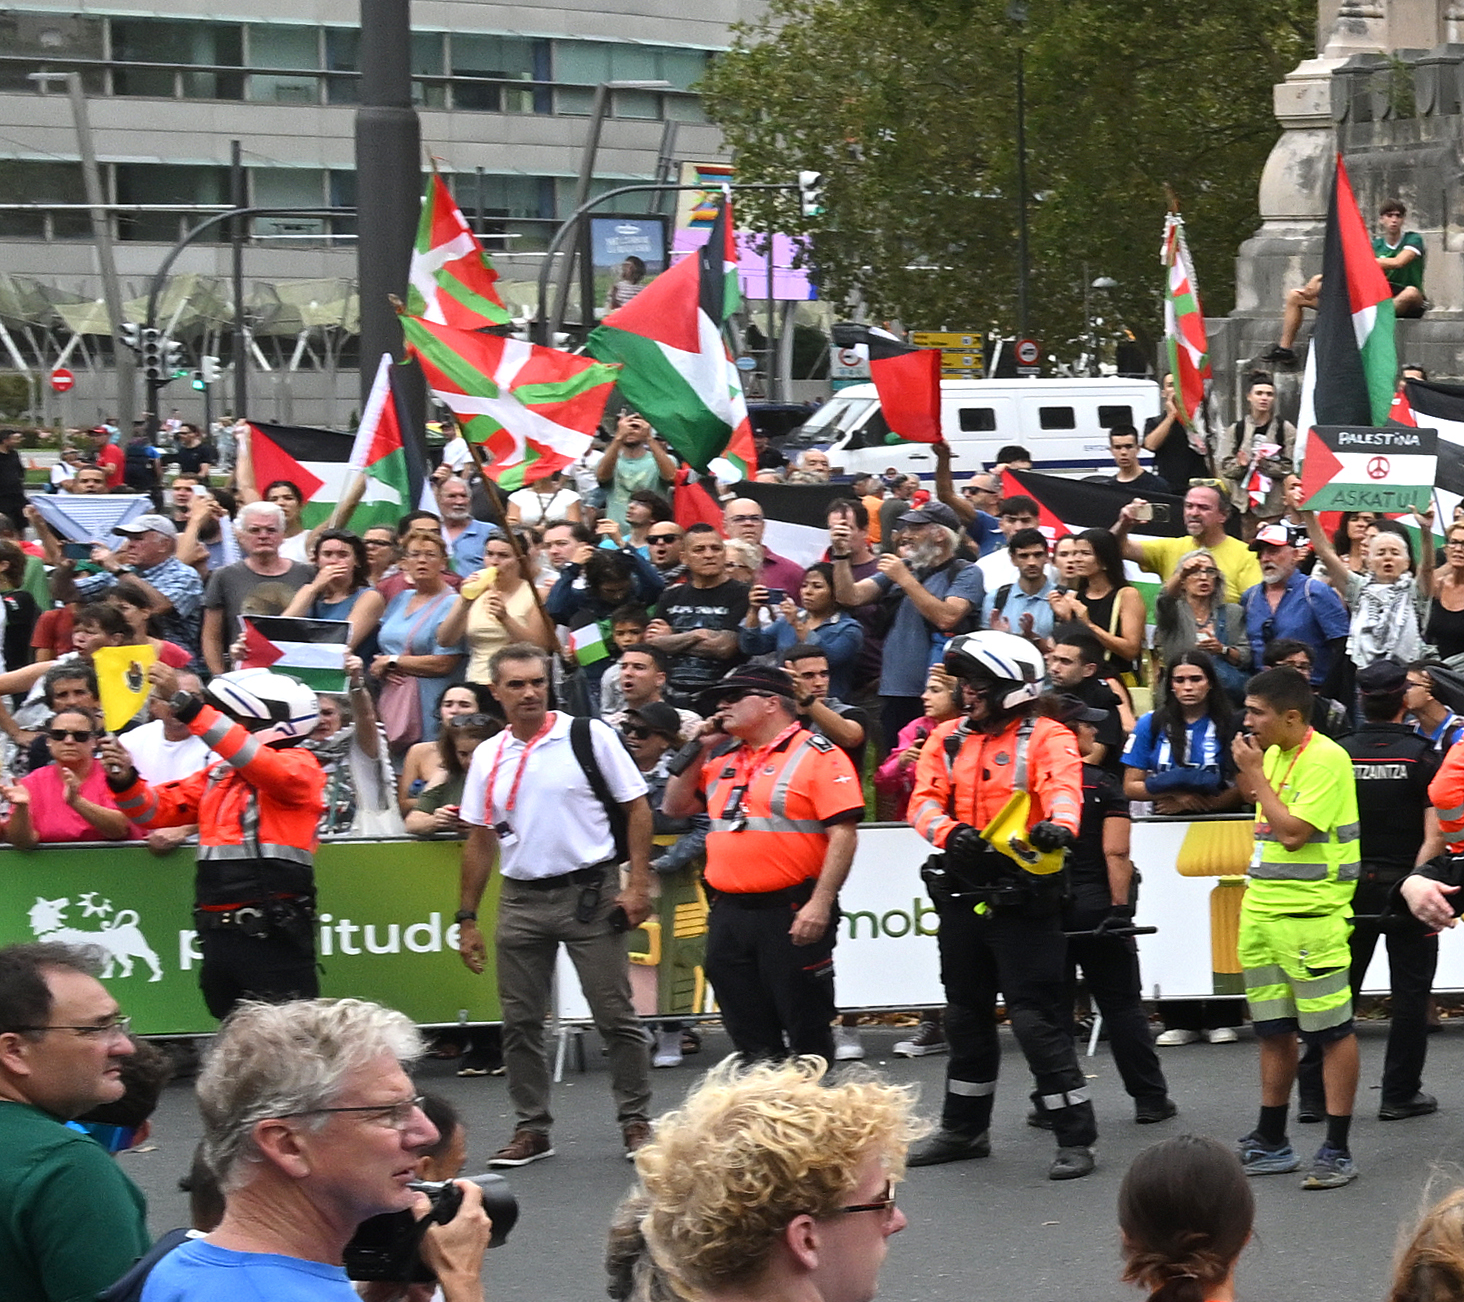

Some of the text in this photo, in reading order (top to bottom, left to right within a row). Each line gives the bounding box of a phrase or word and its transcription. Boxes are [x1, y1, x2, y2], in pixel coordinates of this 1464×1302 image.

[1331, 490, 1418, 509] ASKATU!
[1353, 764, 1408, 780] TZAINTZA
[179, 911, 466, 970] pitude
